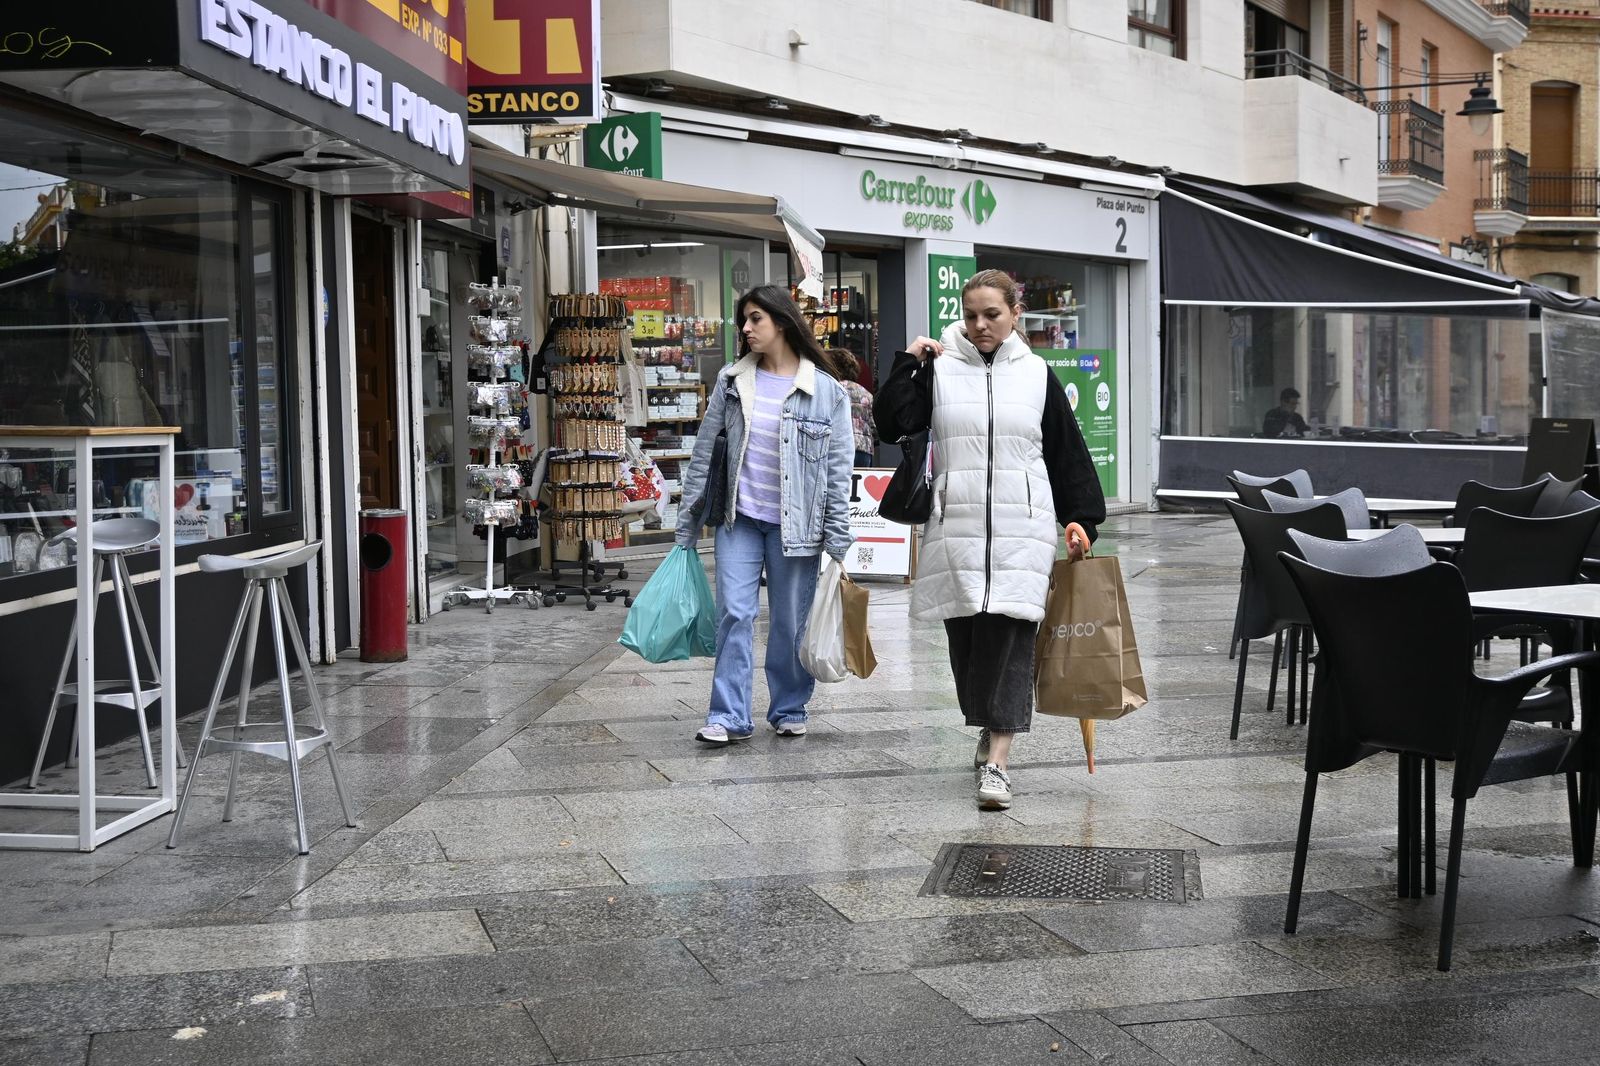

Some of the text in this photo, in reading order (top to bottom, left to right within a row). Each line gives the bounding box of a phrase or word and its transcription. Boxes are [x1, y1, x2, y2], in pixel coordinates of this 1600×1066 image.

[402, 3, 421, 37] EXP.
[433, 26, 448, 55] 033
[201, 0, 465, 166] ESTANCO EL PUNTO
[467, 91, 580, 113] STANCO
[861, 169, 956, 209] Carrefour
[1096, 197, 1145, 215] Plaza del Punto
[903, 211, 954, 233] express
[1115, 216, 1127, 253] 2
[938, 265, 960, 290] 9h
[1056, 357, 1070, 367] socio
[1070, 357, 1078, 367] de
[1097, 391, 1109, 402] BIO
[850, 474, 862, 502] I
[849, 506, 881, 519] Huelv
